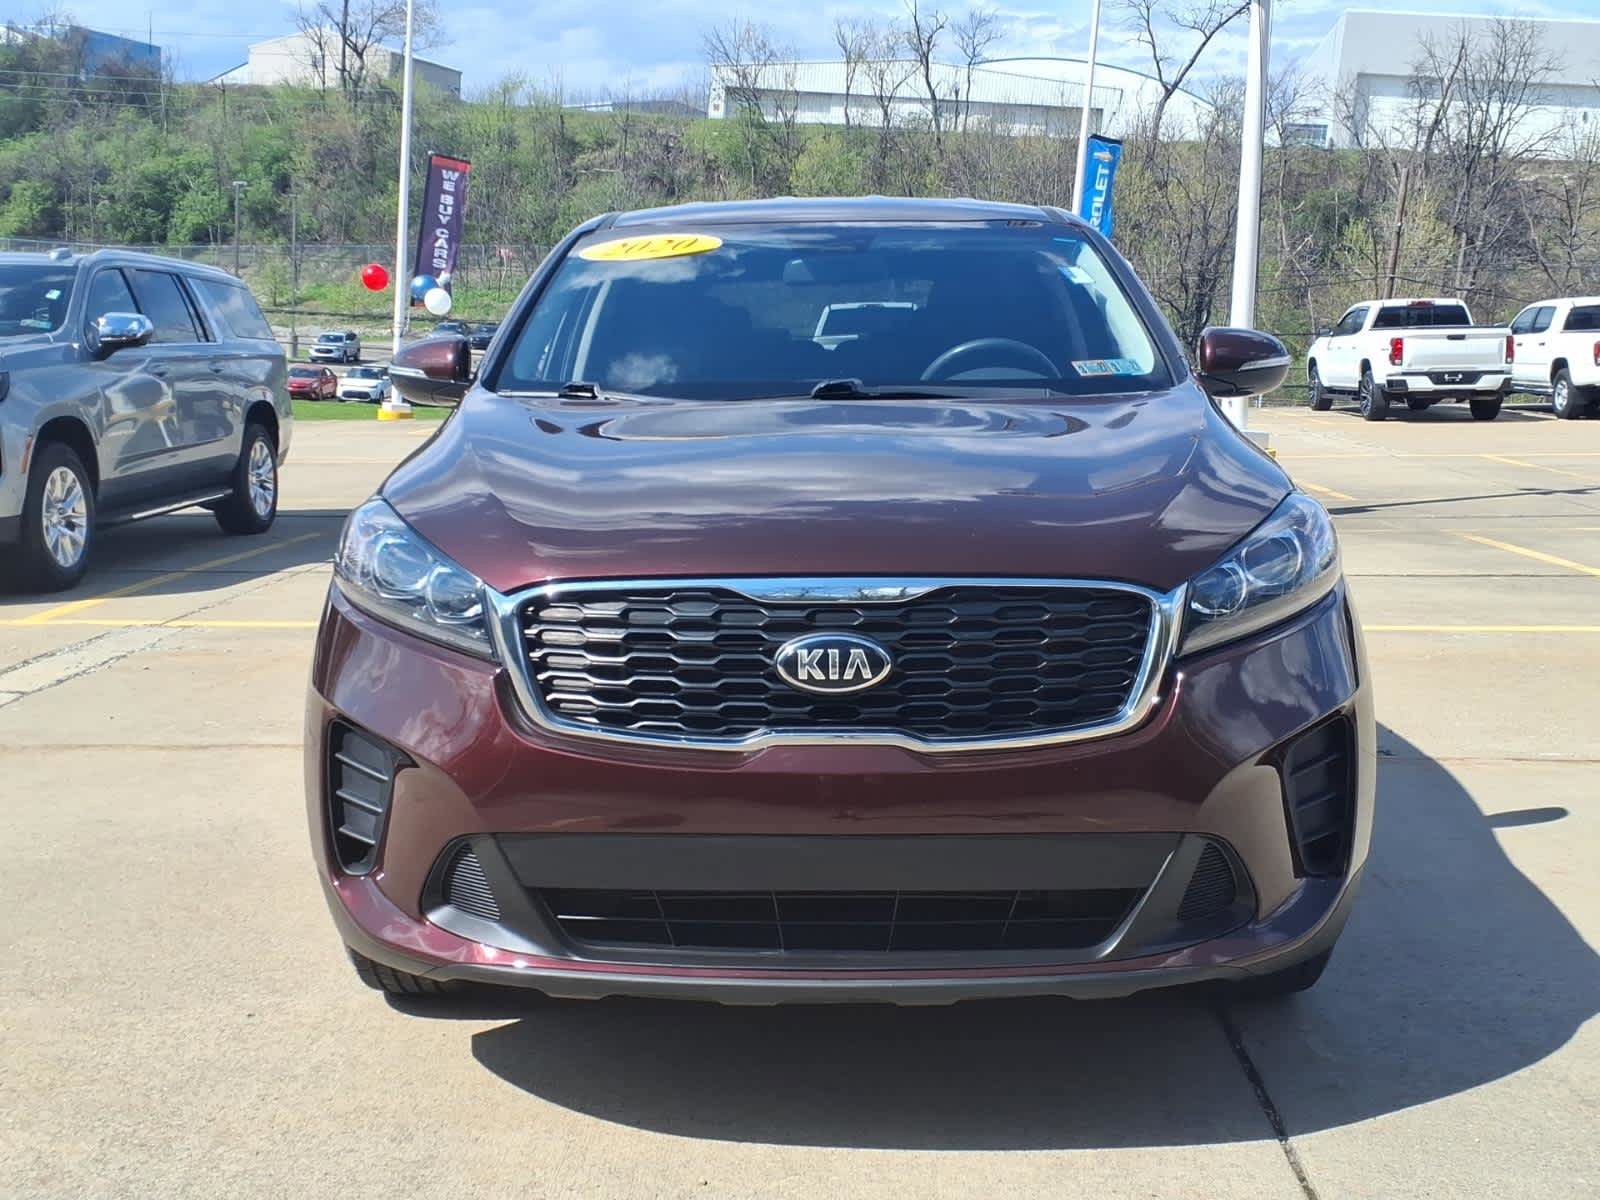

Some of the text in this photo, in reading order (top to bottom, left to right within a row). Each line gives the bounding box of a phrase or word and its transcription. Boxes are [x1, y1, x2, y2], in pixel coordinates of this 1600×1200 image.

[432, 169, 459, 269] WE BUY CARS
[603, 237, 700, 257] 2020
[797, 648, 873, 680] KIA
